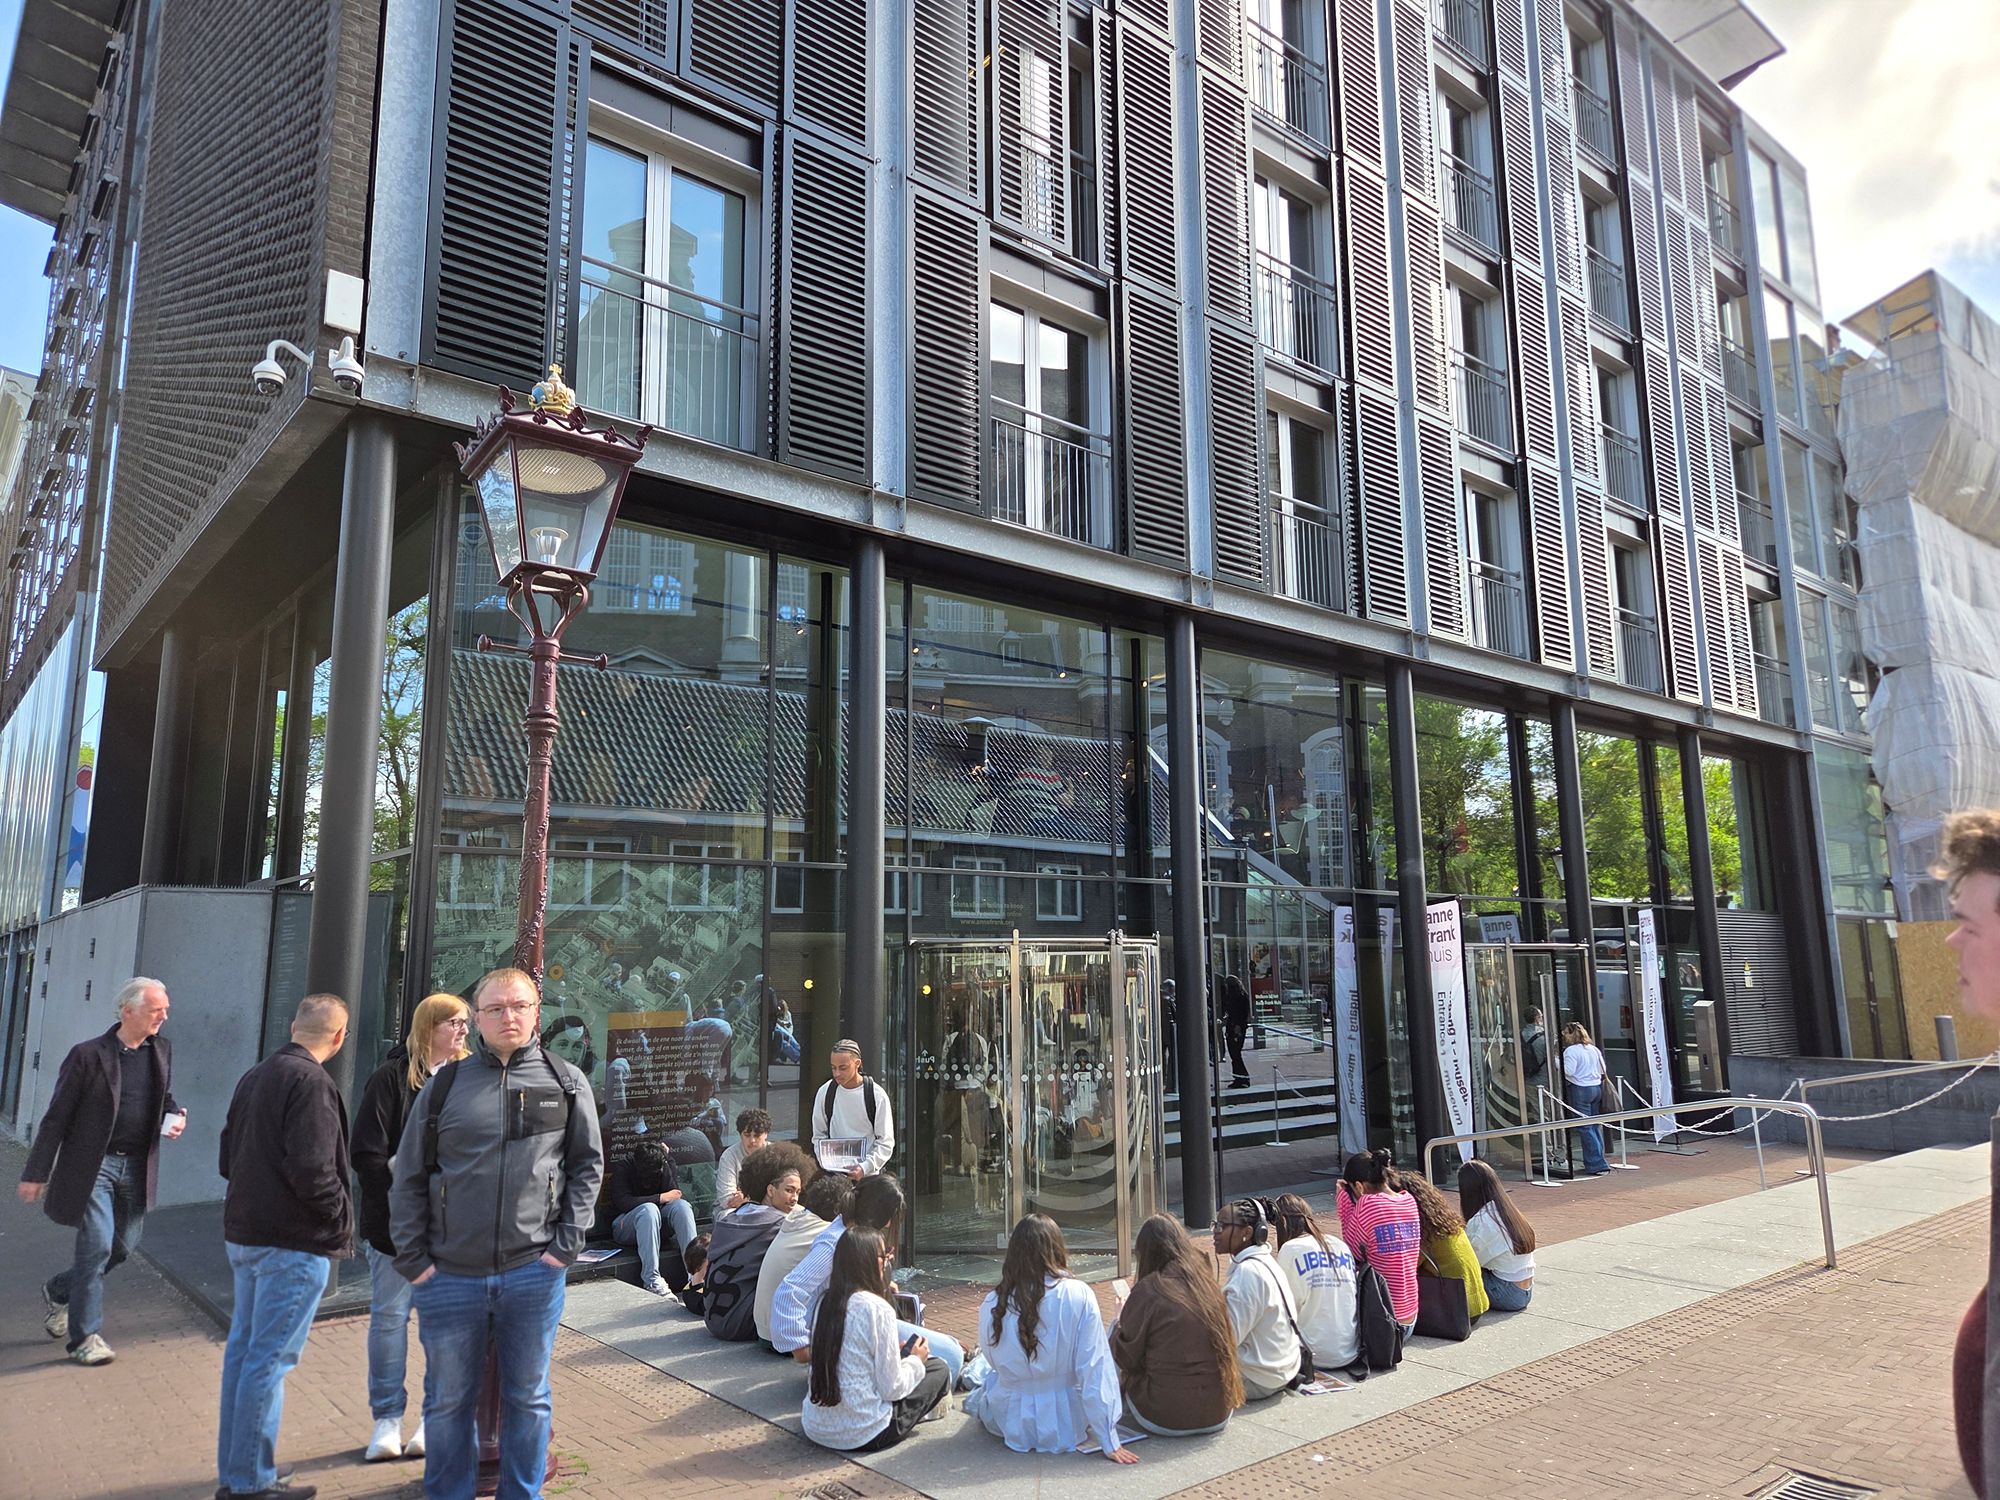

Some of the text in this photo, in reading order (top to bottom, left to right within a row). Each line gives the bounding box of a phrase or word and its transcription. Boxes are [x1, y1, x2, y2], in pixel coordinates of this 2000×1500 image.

[1426, 909, 1454, 924] anne
[1427, 925, 1456, 943] rank
[1485, 920, 1512, 932] anne
[1437, 991, 1446, 1048] Entrance
[1442, 1070, 1463, 1127] museum
